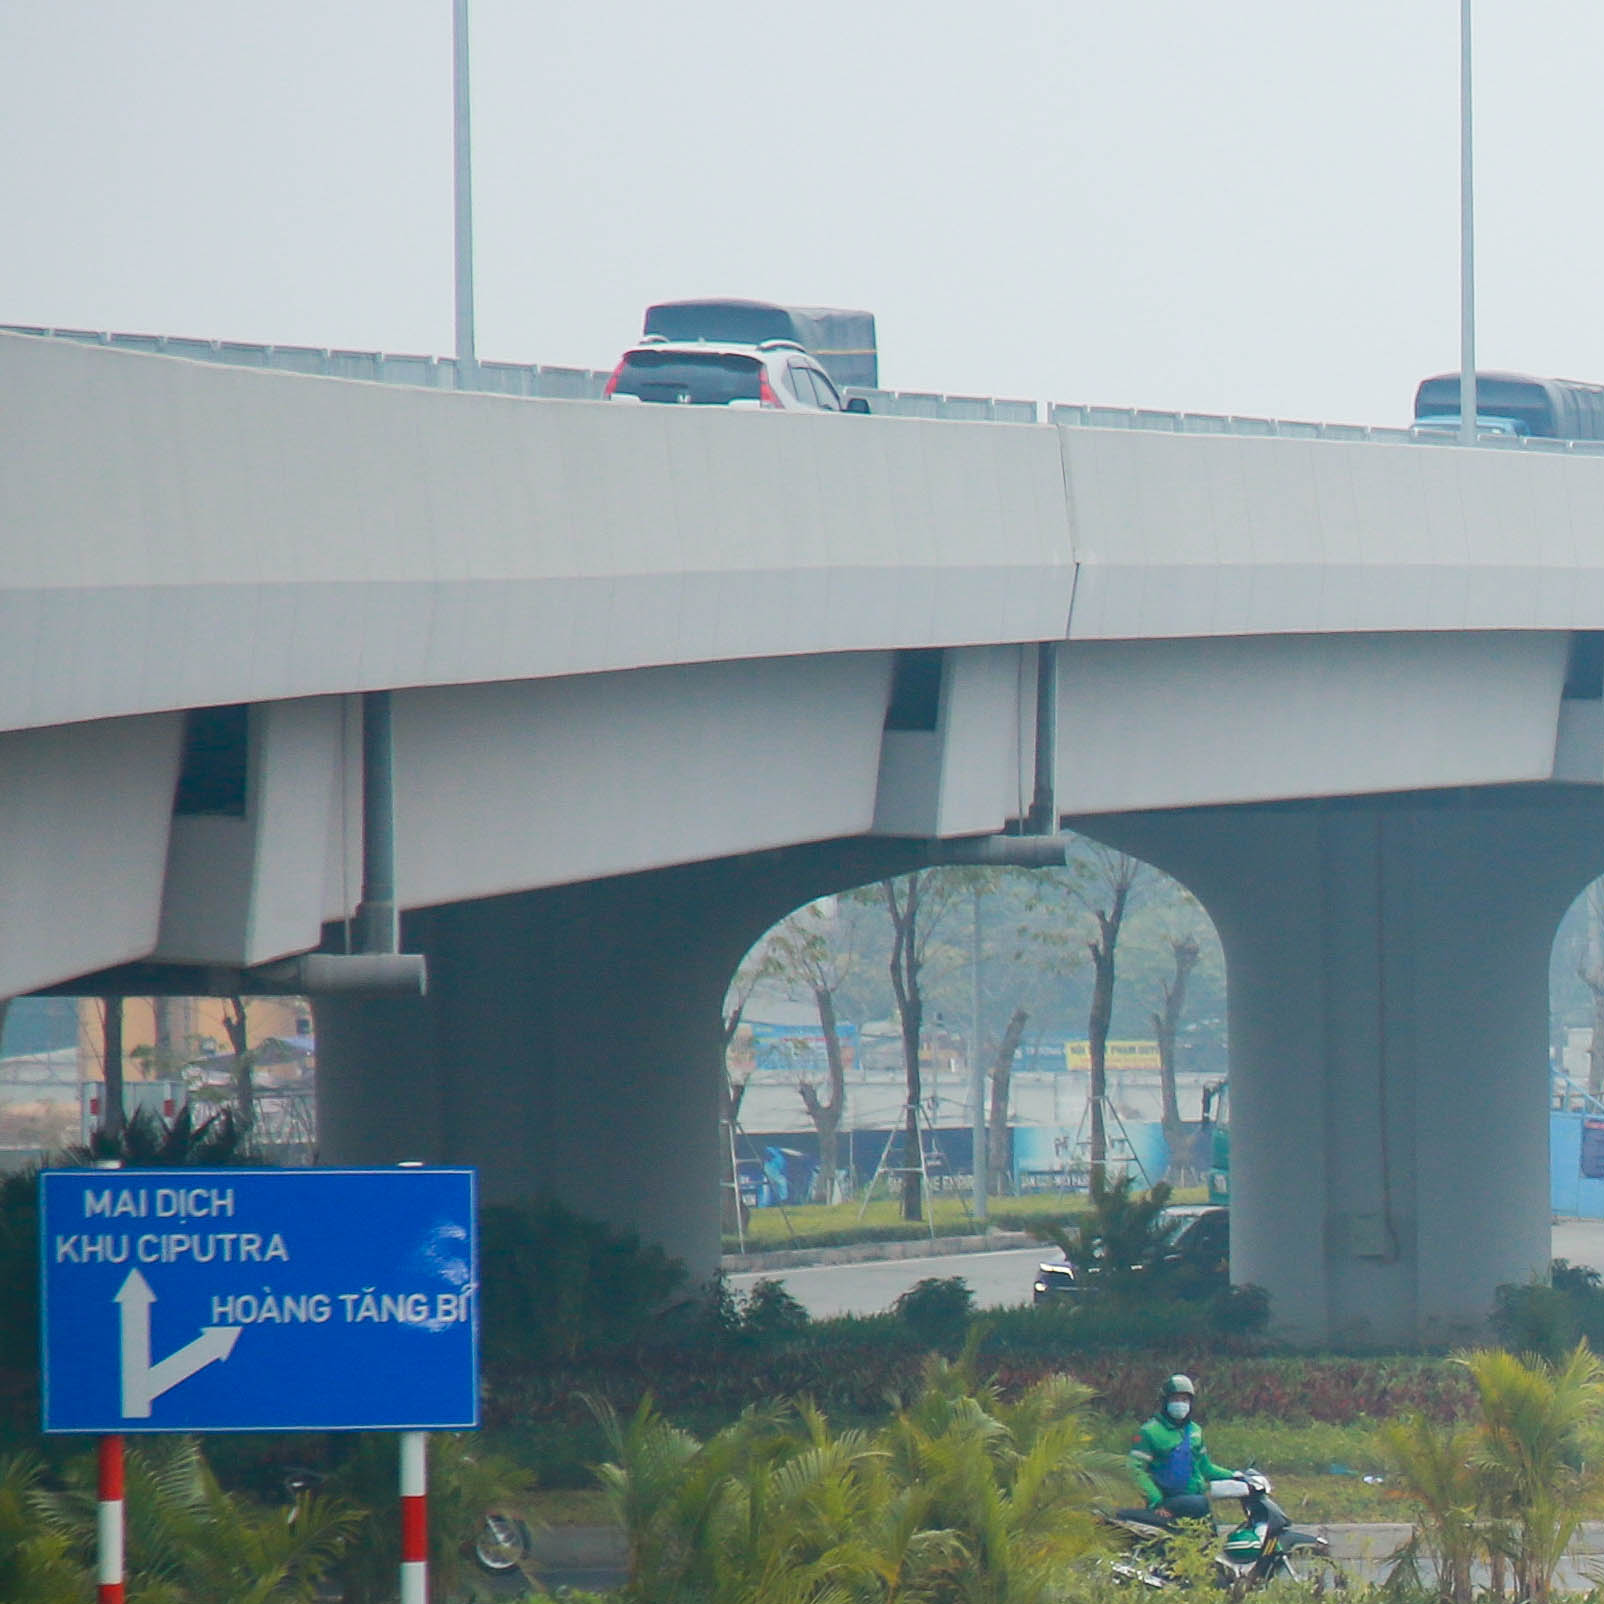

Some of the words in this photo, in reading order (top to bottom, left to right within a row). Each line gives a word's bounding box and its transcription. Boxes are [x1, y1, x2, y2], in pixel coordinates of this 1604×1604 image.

[84, 1189, 147, 1218] MAI
[156, 1189, 234, 1225] DỊCH
[56, 1234, 130, 1264] KHU
[138, 1233, 289, 1263] CIPUTRA
[211, 1286, 332, 1324] HOÀNG
[339, 1286, 429, 1323] TĂNG
[437, 1284, 475, 1322] BÍ
